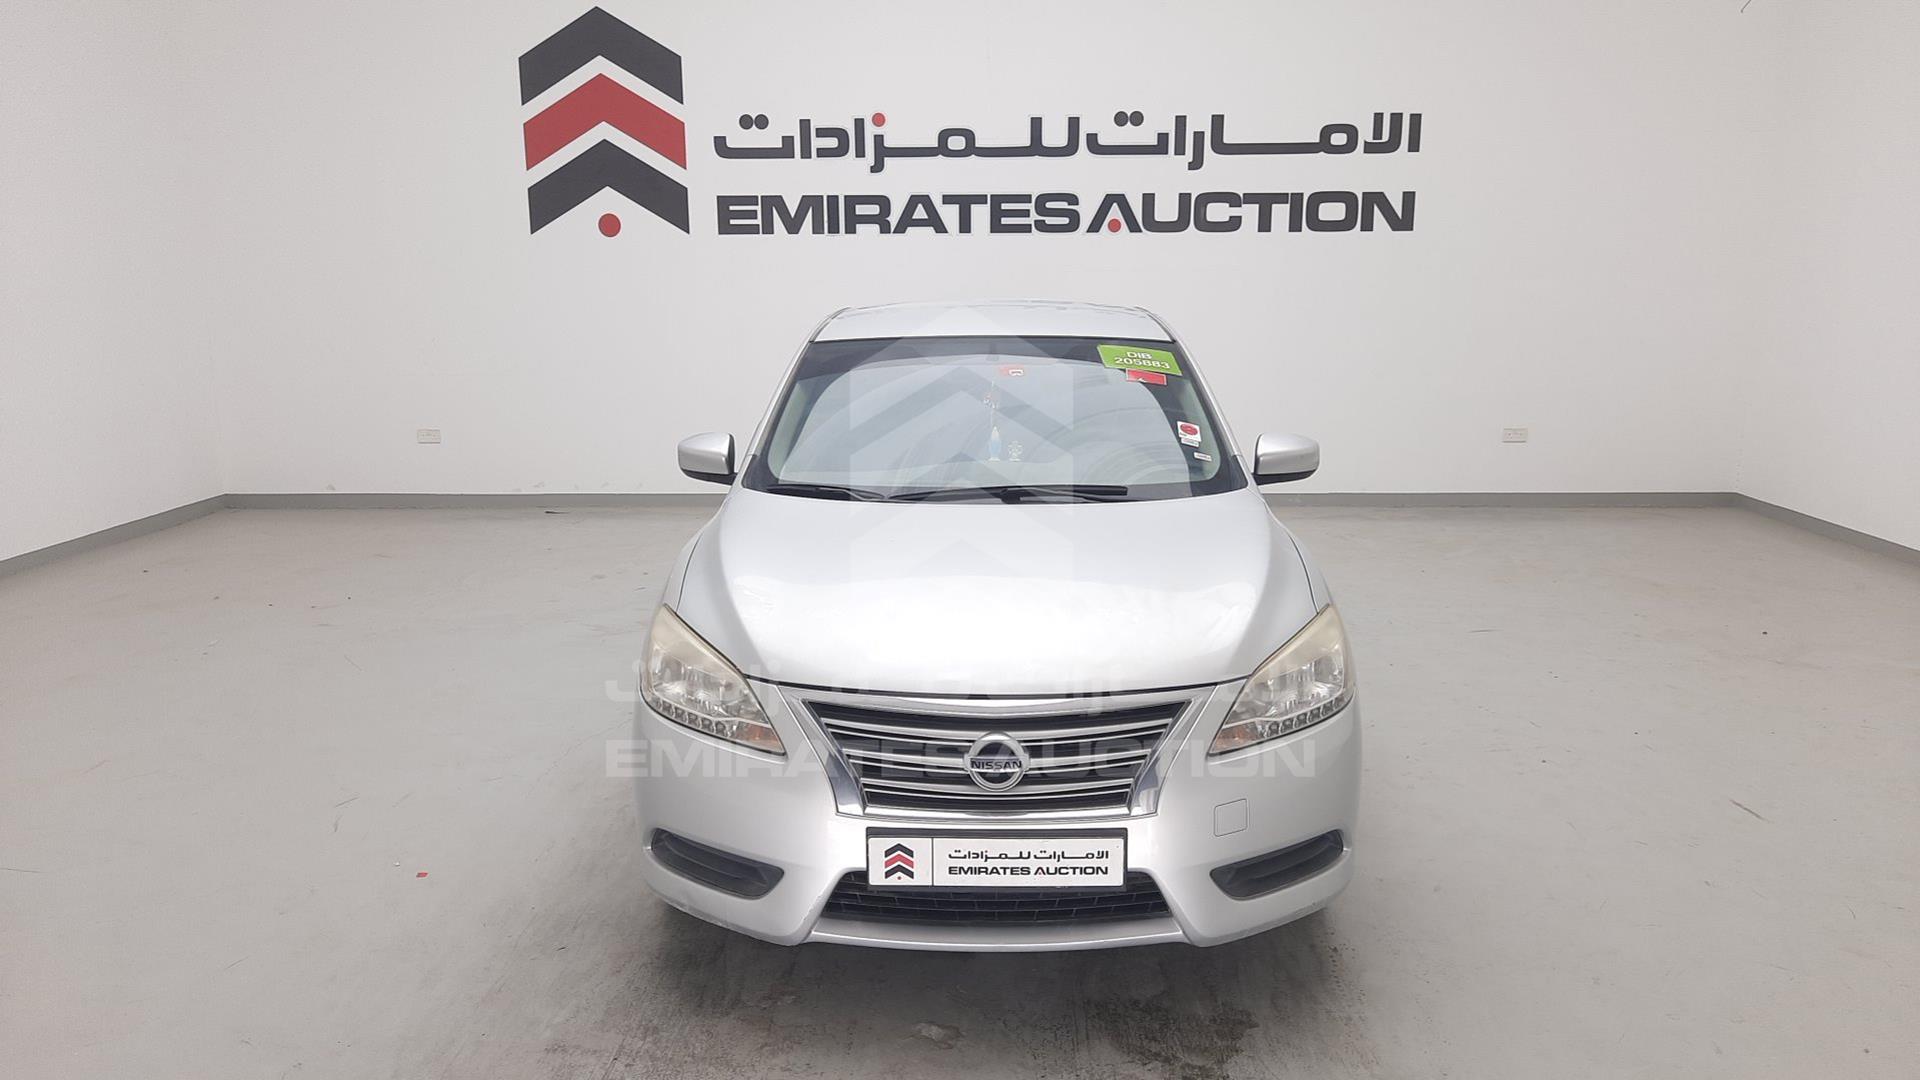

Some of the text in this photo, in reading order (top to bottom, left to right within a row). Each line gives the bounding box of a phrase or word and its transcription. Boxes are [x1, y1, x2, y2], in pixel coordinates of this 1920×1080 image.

[713, 110, 1423, 174] الامارات للمزادات
[716, 190, 1417, 236] EMIRATES AUCTION
[1126, 351, 1152, 360] DIB
[970, 760, 1022, 770] NISSAN
[948, 866, 1109, 876] EMIRATES AUCTION
